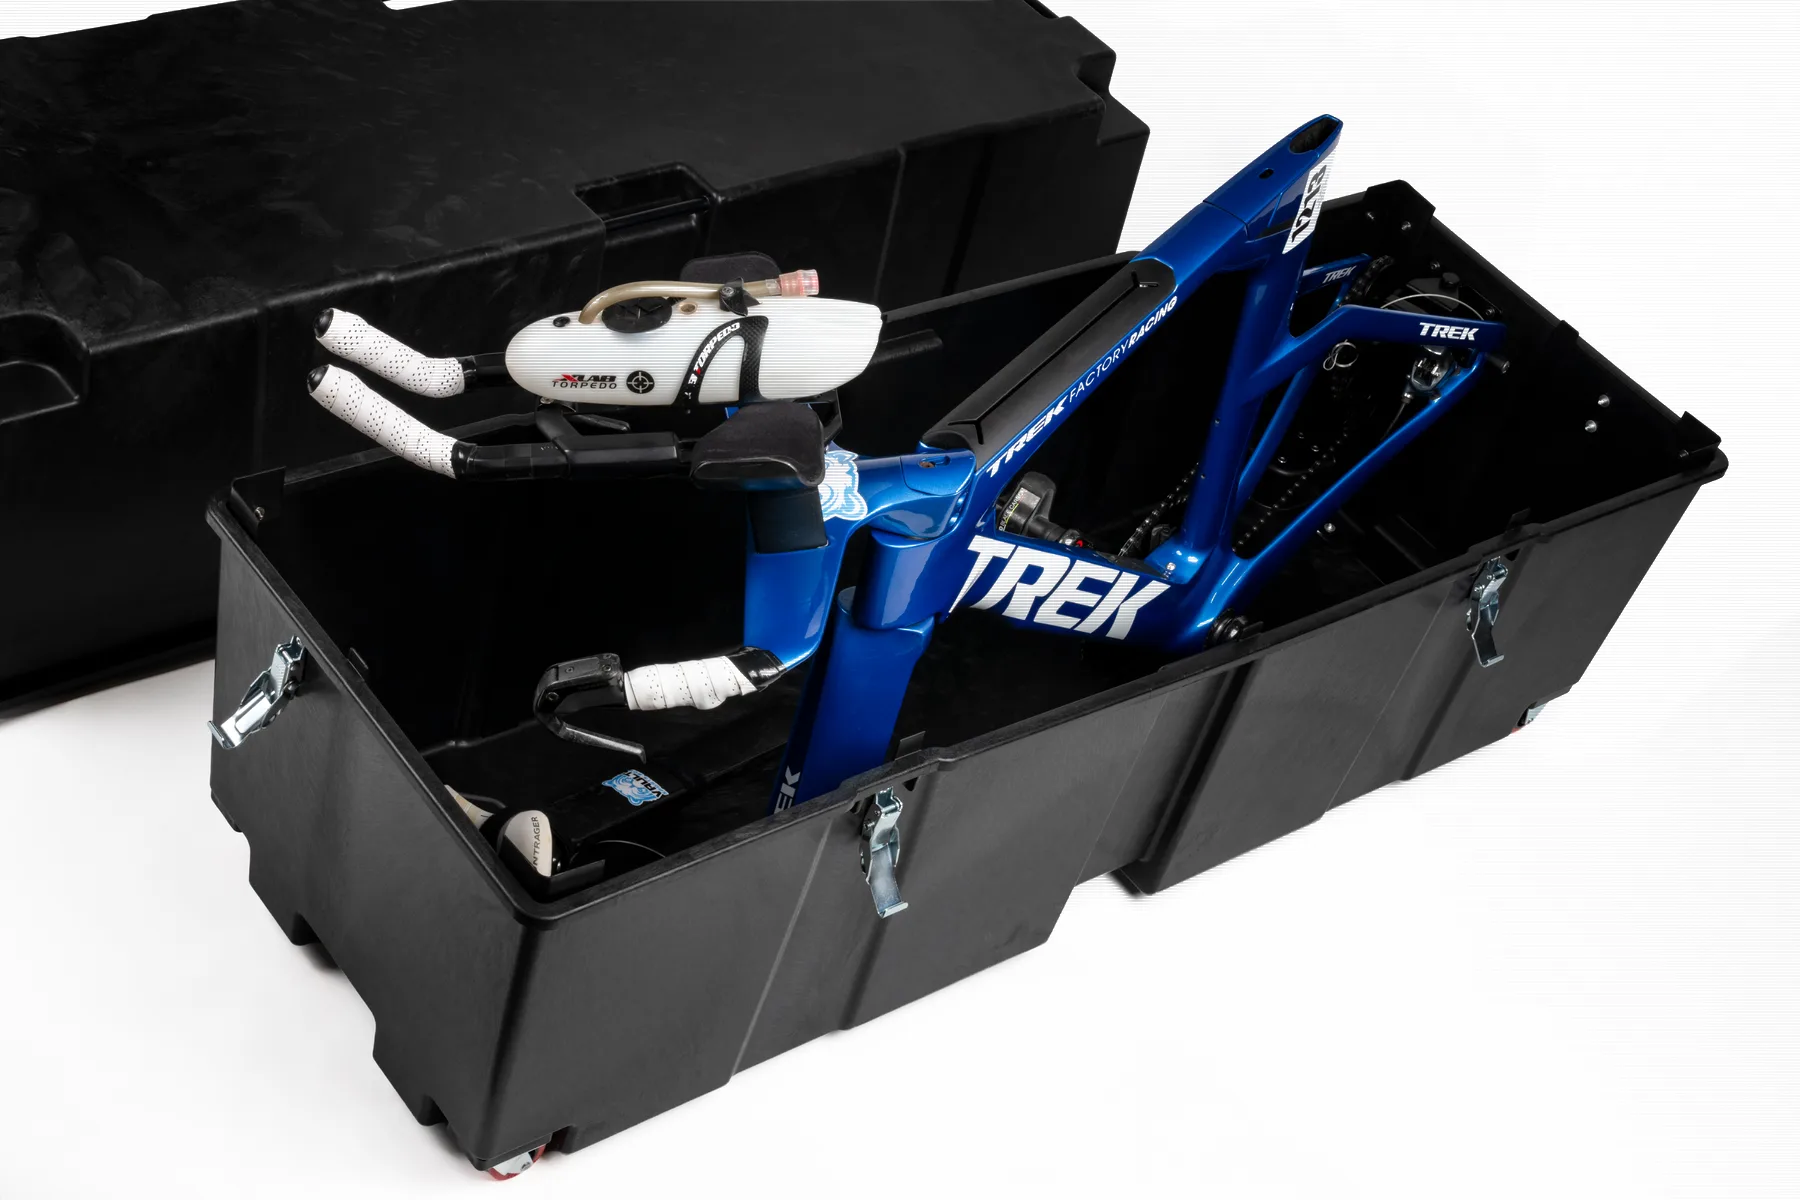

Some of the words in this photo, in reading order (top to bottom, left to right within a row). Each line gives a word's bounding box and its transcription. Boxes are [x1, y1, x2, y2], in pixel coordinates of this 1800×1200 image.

[1323, 266, 1357, 283] TREK
[1419, 322, 1479, 341] TREK
[551, 381, 618, 389] TORPEDO
[552, 373, 617, 382] XLAB
[986, 396, 1067, 478] TREK
[949, 535, 1171, 640] TREK
[623, 772, 661, 797] VAULT
